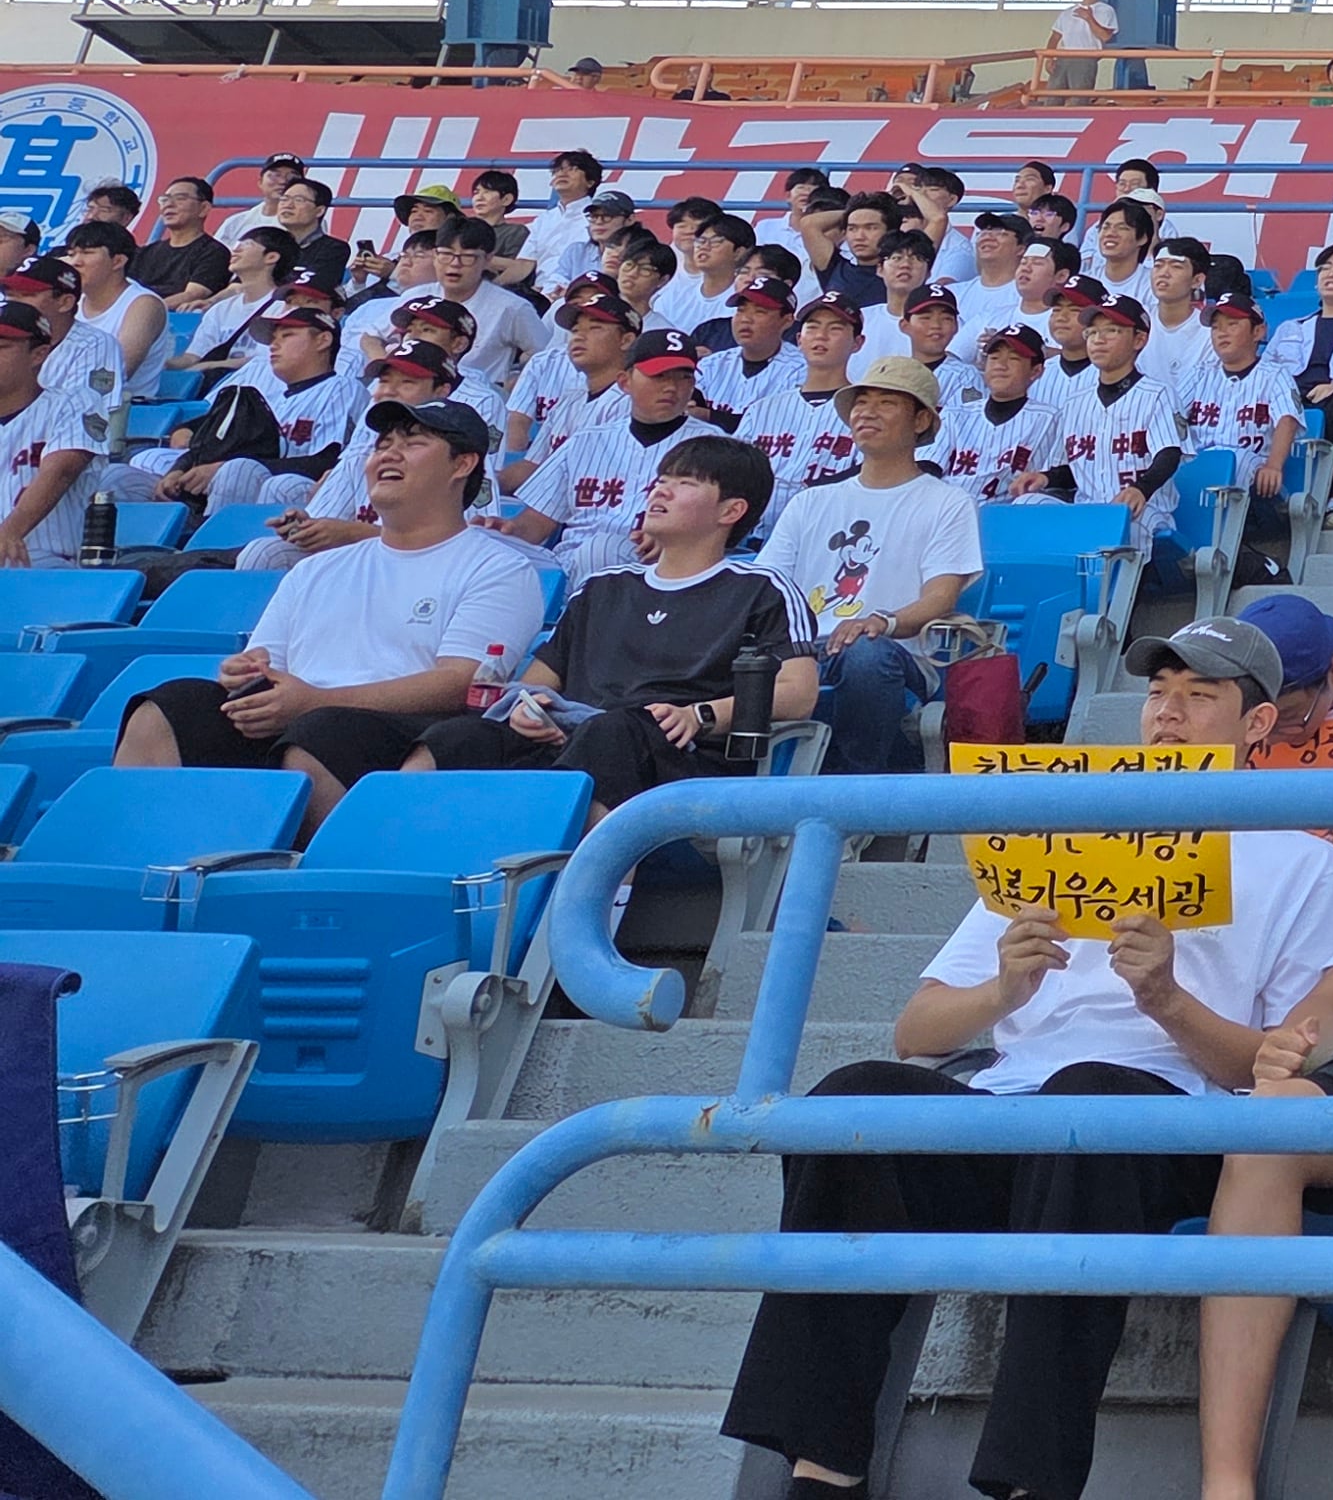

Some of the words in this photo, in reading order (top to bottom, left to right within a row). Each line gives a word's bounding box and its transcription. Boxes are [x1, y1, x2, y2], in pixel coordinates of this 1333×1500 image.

[929, 283, 945, 297] S
[1064, 275, 1082, 289] S
[666, 331, 684, 352] S
[573, 476, 626, 509] 世光
[981, 477, 1000, 501] 4
